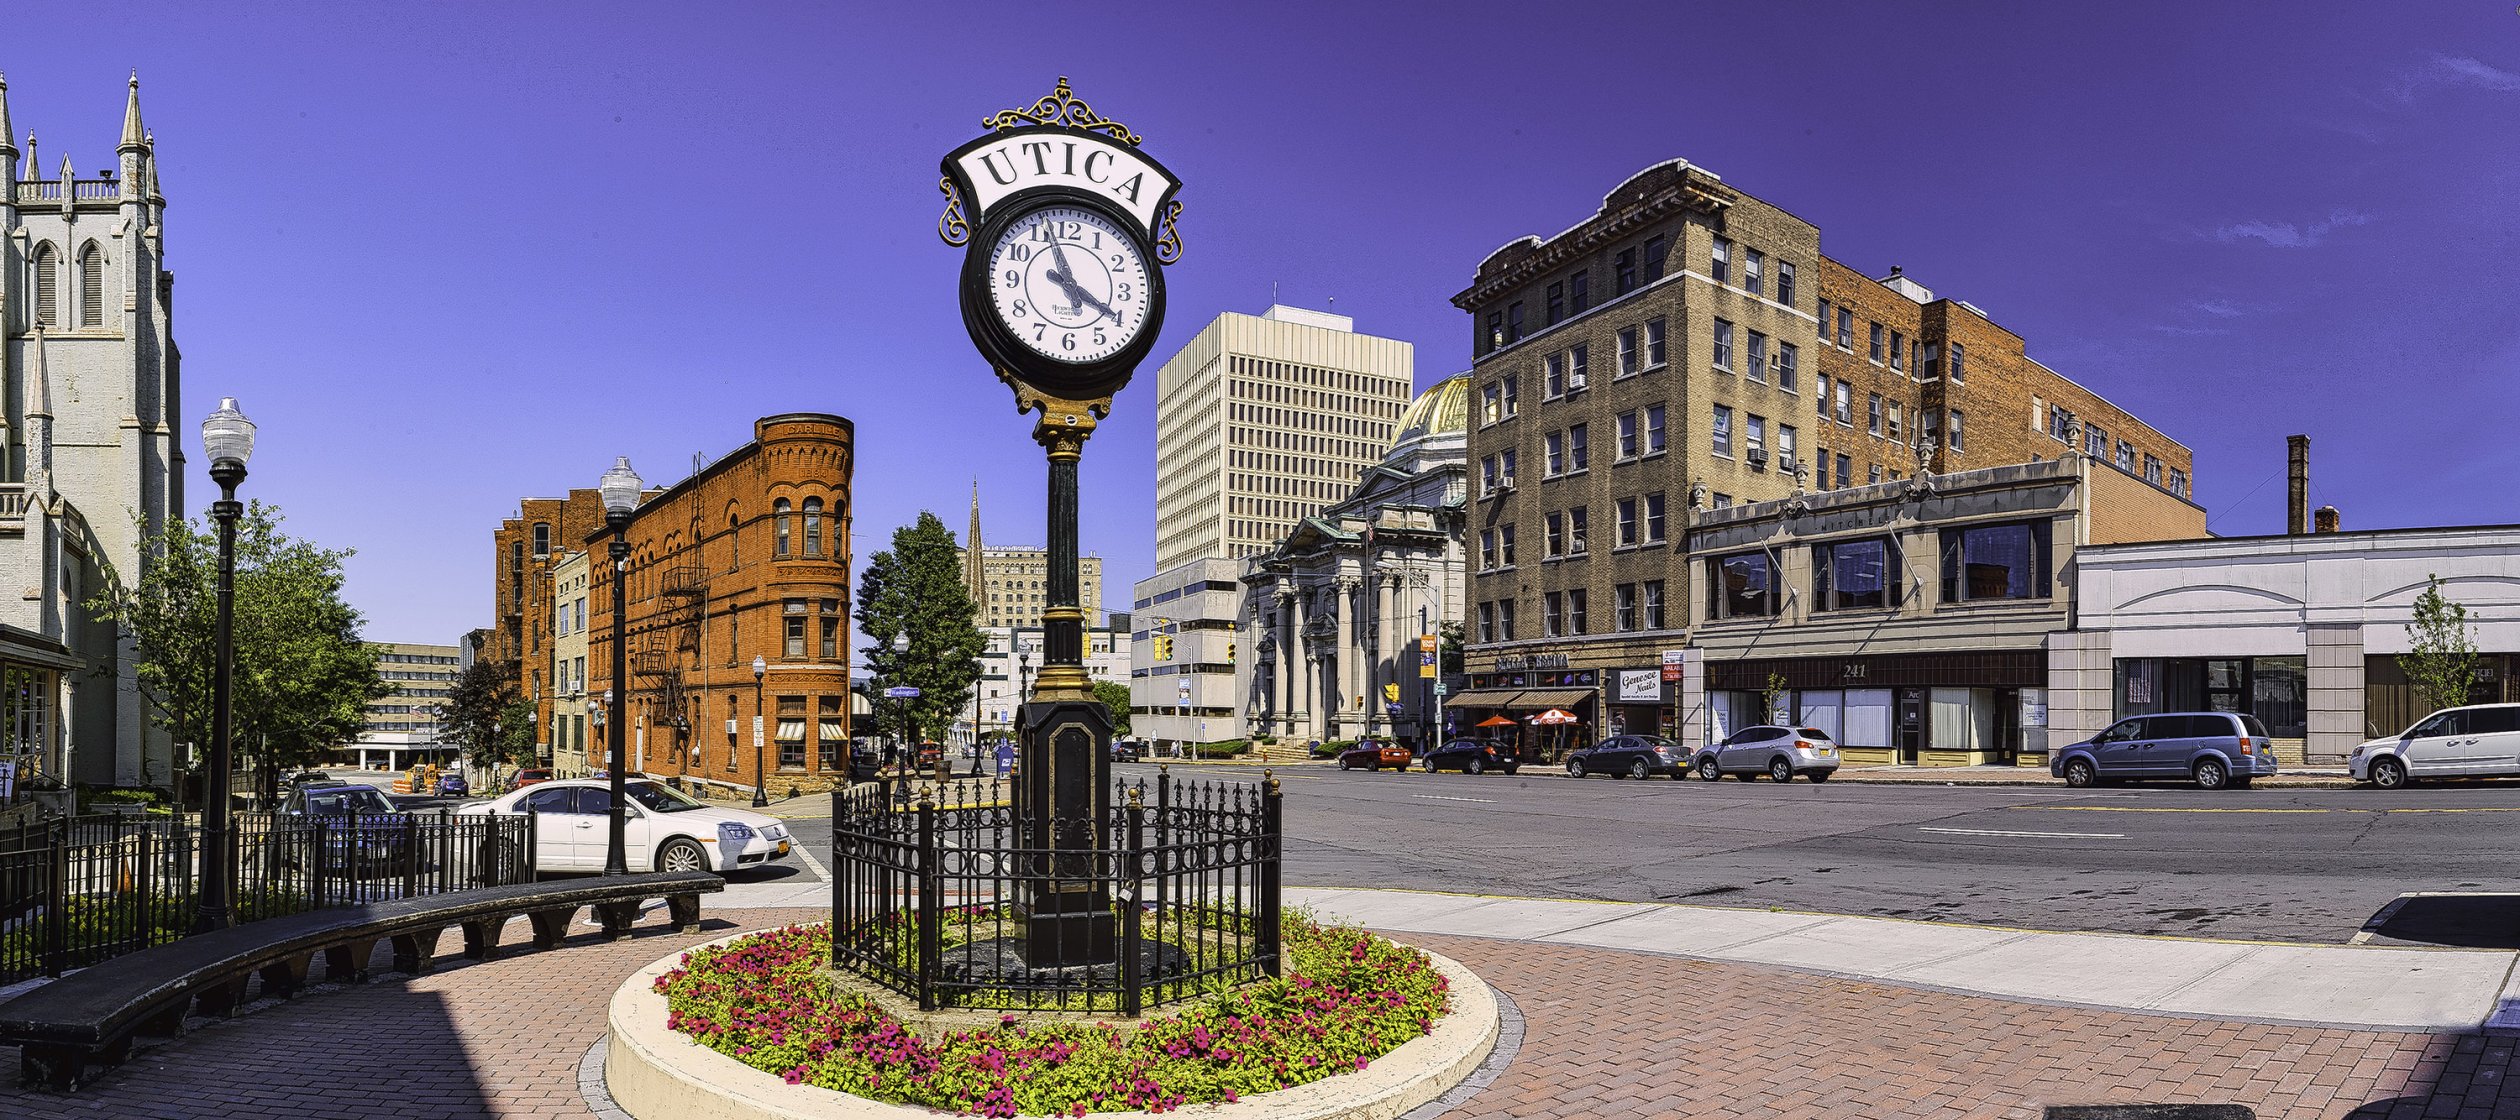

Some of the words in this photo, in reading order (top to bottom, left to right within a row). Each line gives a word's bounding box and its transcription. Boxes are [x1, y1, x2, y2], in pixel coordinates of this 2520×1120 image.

[977, 141, 1144, 206] UTICA
[1057, 221, 1082, 241] 12
[1091, 232, 1102, 250] 1
[1006, 242, 1031, 262] 10
[1111, 254, 1125, 273] 2
[1005, 270, 1020, 288] 9
[1117, 282, 1131, 301] 3
[1012, 299, 1027, 318] 8
[1110, 309, 1124, 327] 4
[1033, 322, 1047, 341] 7
[1093, 327, 1107, 345] 5
[1062, 333, 1076, 351] 6
[787, 425, 840, 436] CARLILE
[1622, 671, 1657, 689] Genesee
[1843, 664, 1866, 678] 241
[1635, 680, 1656, 694] Nails
